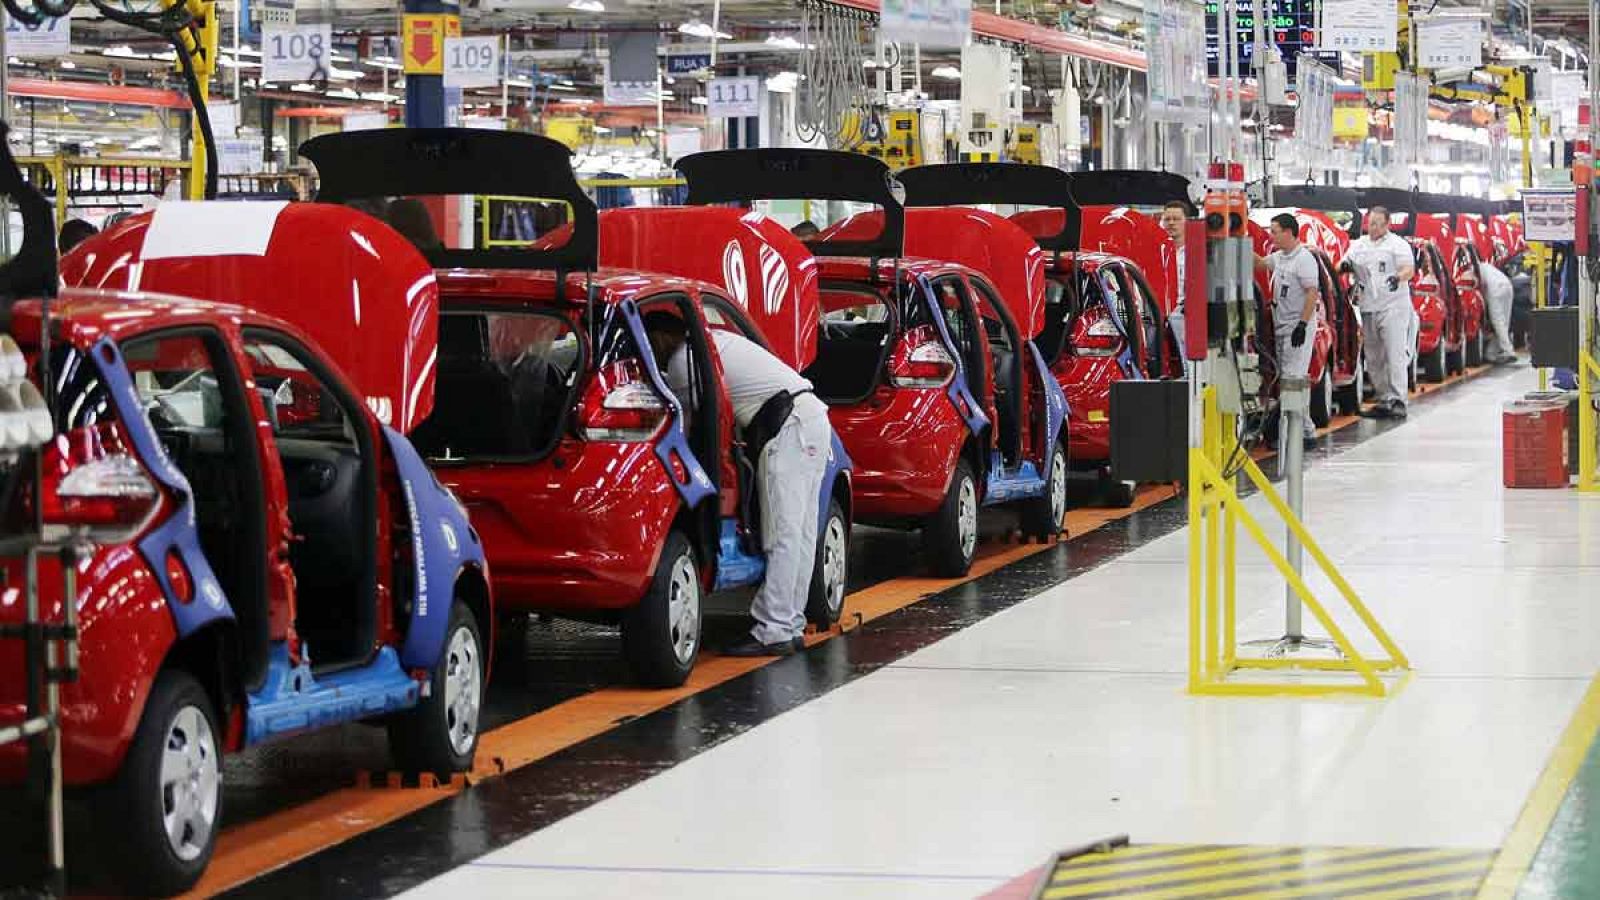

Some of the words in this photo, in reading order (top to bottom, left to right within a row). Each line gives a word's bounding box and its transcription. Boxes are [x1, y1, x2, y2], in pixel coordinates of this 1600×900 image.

[1233, 15, 1294, 28] roução
[271, 34, 324, 60] 108
[451, 45, 493, 69] 109
[714, 84, 752, 103] 111
